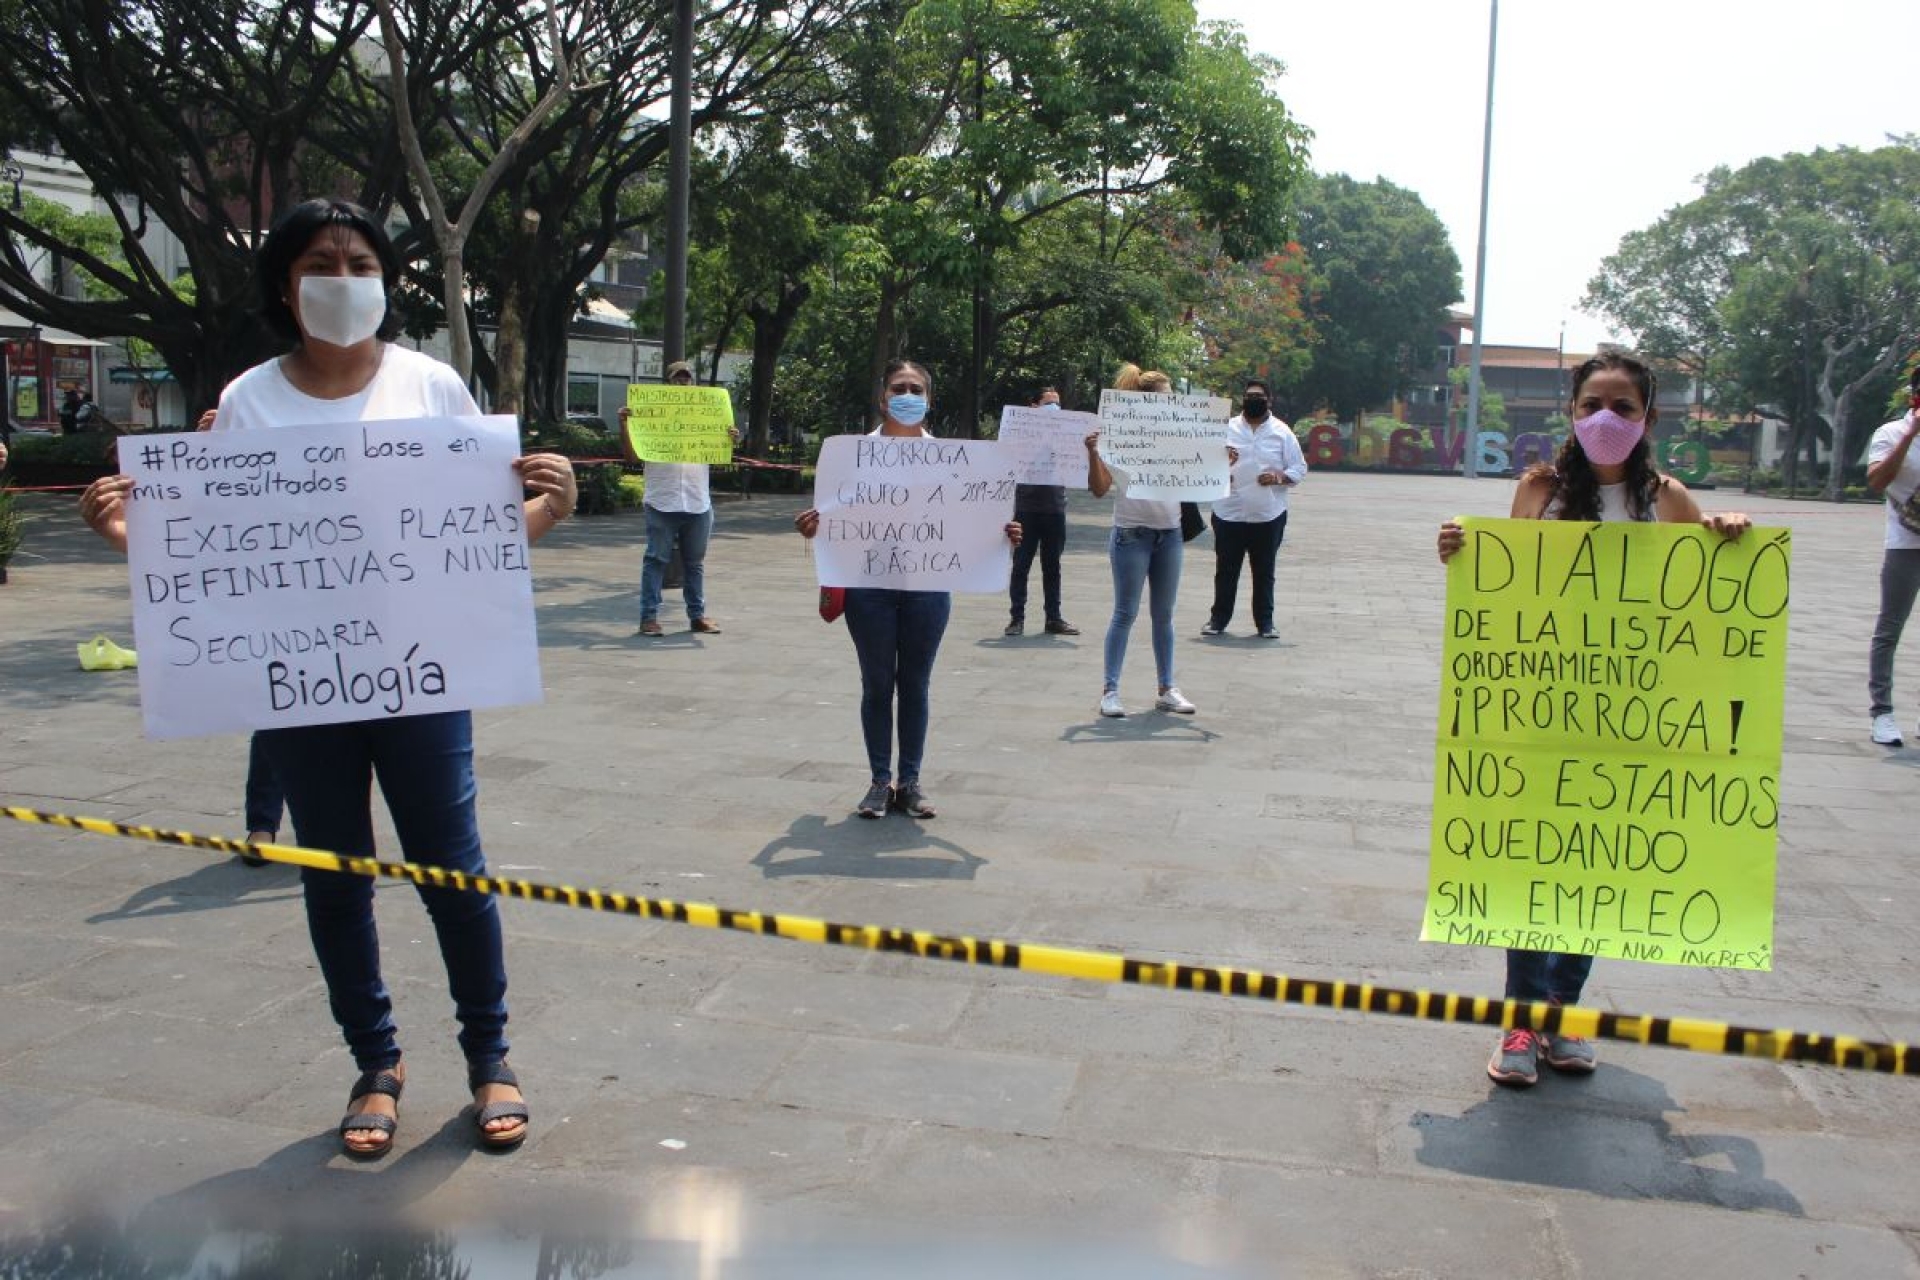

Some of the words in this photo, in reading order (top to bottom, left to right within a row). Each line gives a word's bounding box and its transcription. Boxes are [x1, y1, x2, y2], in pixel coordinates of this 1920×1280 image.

[140, 440, 277, 480] #Prórroga
[303, 445, 345, 464] con
[363, 428, 425, 459] base
[447, 436, 480, 454] en
[132, 483, 182, 501] mis
[204, 469, 348, 497] resultados
[838, 481, 910, 507] GRUPO
[927, 484, 944, 504] A
[164, 513, 364, 559] EXIGIMOS
[400, 503, 519, 540] PLAZAS
[827, 514, 944, 543] EDUCACIÓN
[144, 549, 416, 605] DEFINITIVAS
[444, 543, 528, 577] NIVEL
[863, 546, 962, 575] BÁSICA
[168, 616, 383, 667] SECUNDARIA
[1454, 608, 1492, 641] DE
[1516, 610, 1560, 646] LA
[1583, 612, 1699, 656] LISTA
[1722, 626, 1768, 658] DE
[266, 643, 446, 715] Biología
[1446, 751, 1526, 798] NOS
[1555, 759, 1779, 830] ESTAMOS
[1443, 816, 1688, 873] QUEDANDO
[1434, 881, 1488, 919] SIN
[1527, 880, 1722, 945] EMPLEO
